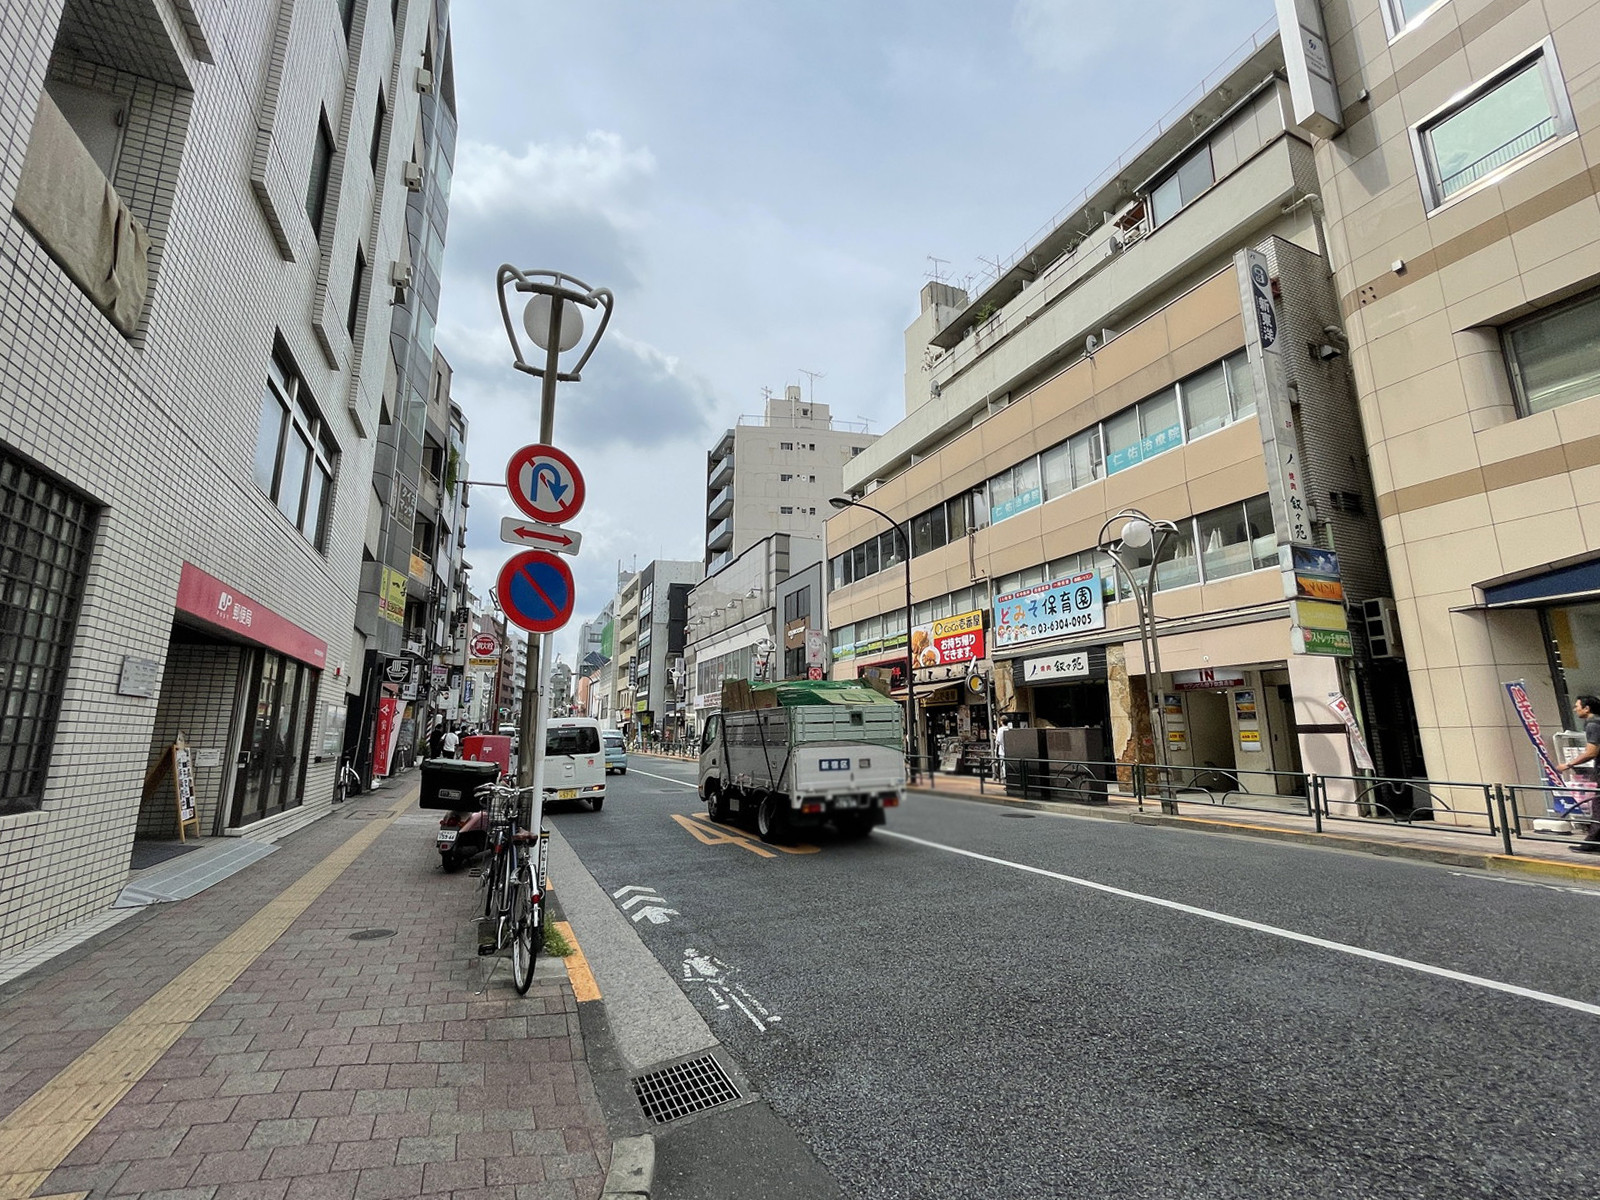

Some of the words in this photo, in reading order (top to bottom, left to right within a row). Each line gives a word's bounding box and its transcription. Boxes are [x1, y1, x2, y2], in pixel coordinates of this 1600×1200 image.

[1258, 296, 1275, 343] 新東洋
[232, 603, 253, 627] 郵便局
[1000, 586, 1092, 625] どみそ保育園
[940, 633, 976, 650] お持ち帰り
[1200, 668, 1215, 682] IN
[821, 760, 848, 769] 新宿区
